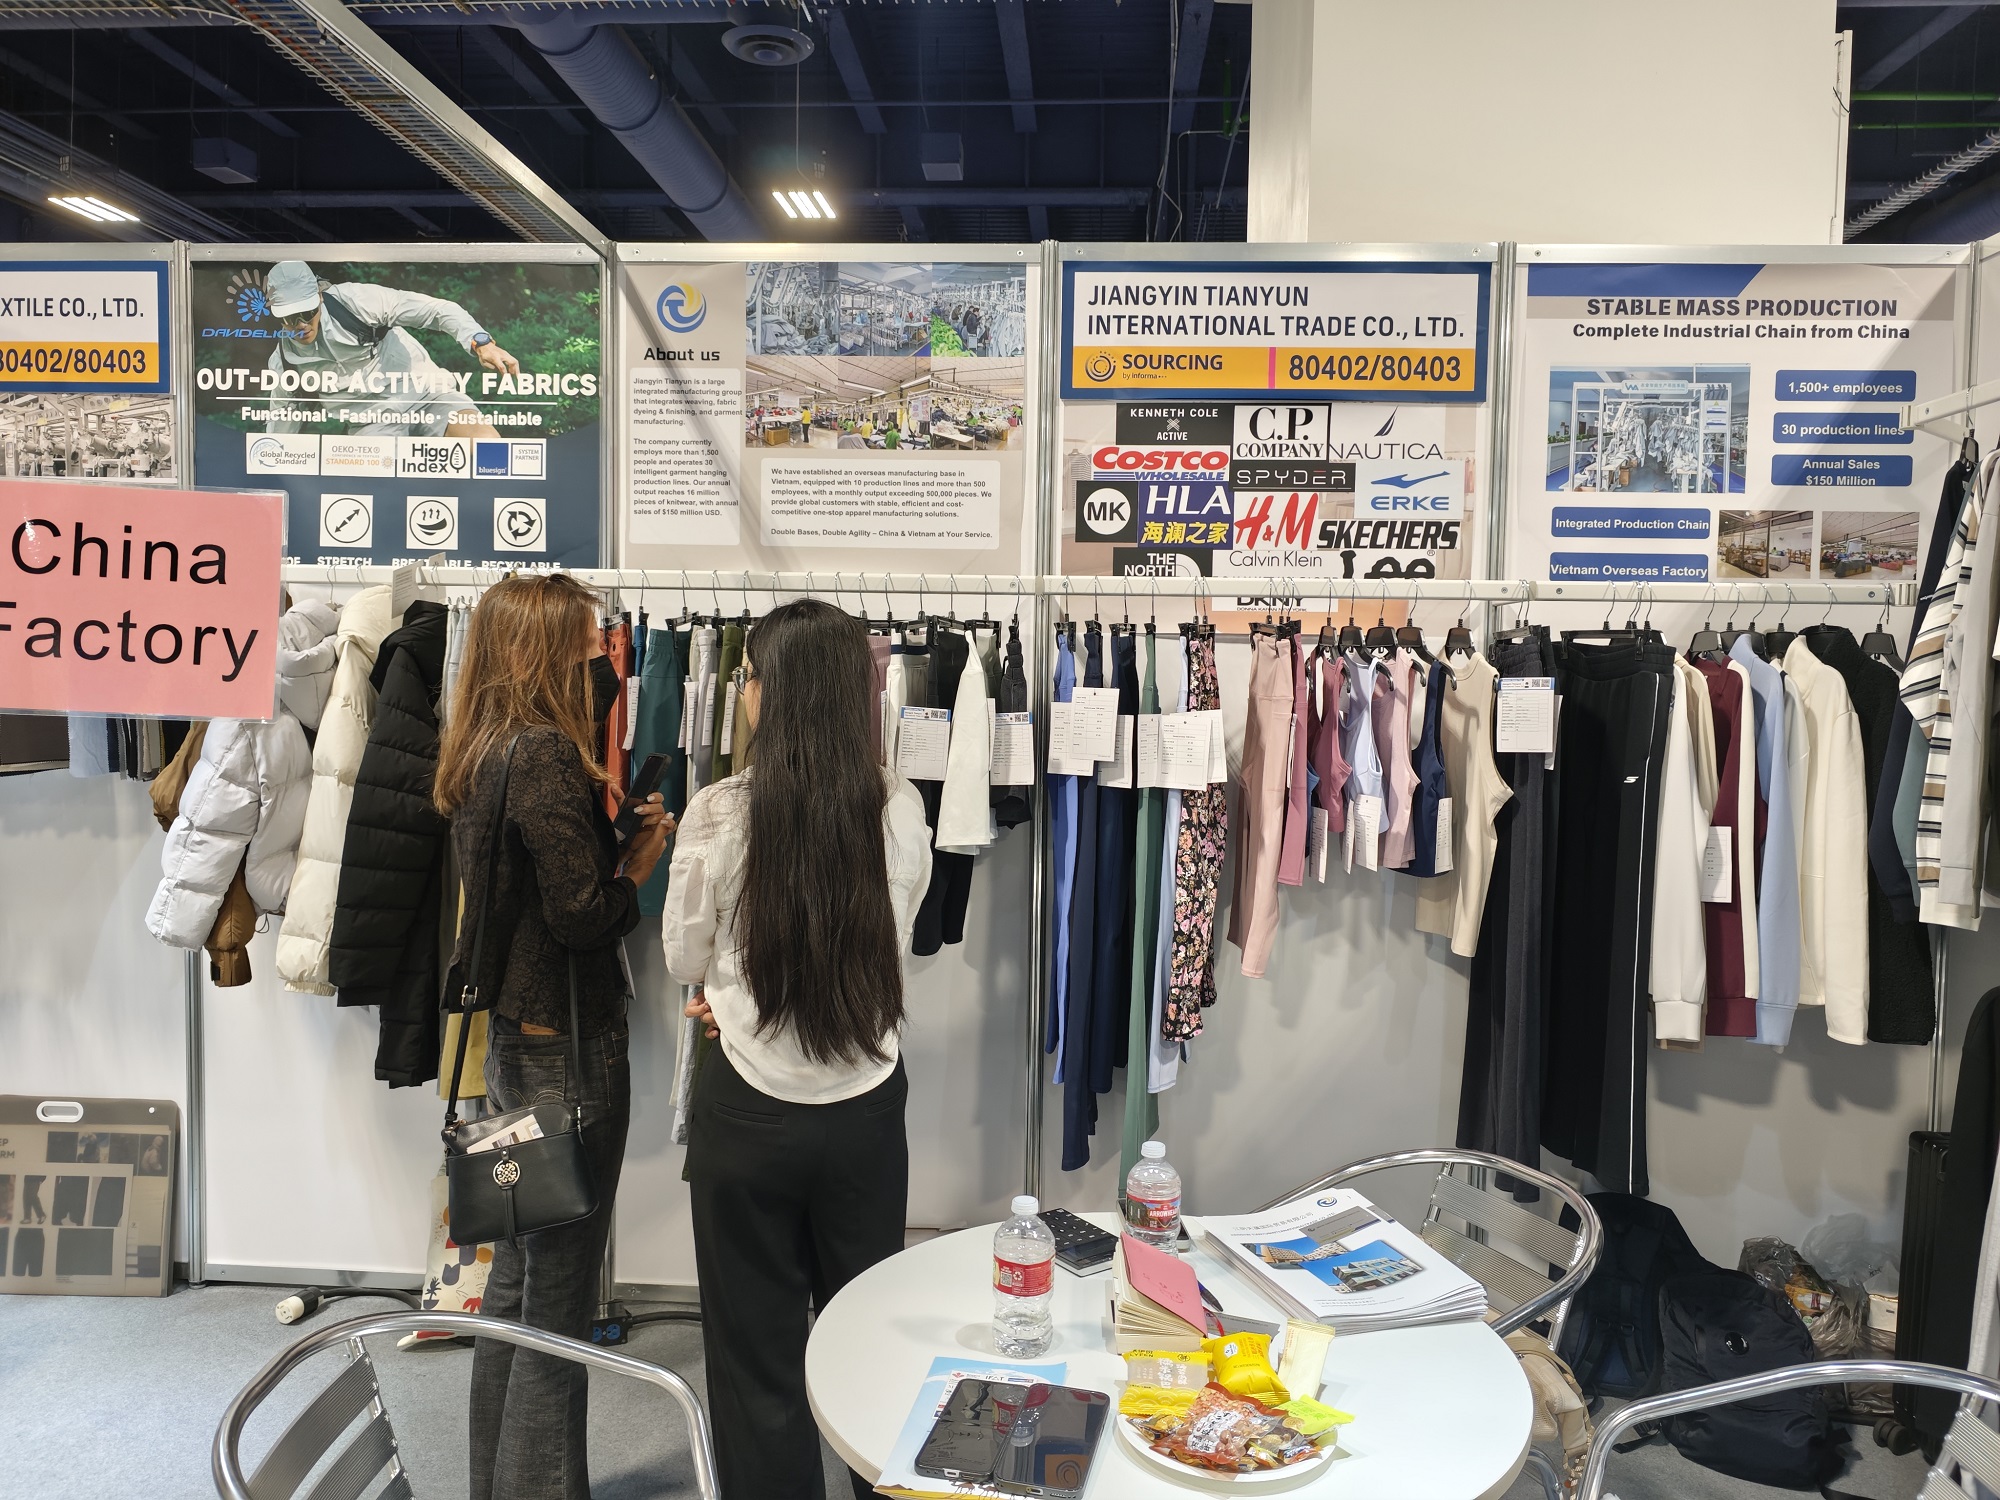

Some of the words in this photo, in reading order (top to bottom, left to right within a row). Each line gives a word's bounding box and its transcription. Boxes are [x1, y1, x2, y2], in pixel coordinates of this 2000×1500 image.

[1087, 286, 1197, 306] JIANGYIN
[1205, 286, 1309, 307] TIANYUN
[0, 298, 54, 316] XTILE
[60, 298, 97, 320] CO.,
[102, 298, 144, 318] LTD.
[1586, 299, 1671, 316] STABLE
[1676, 299, 1740, 316] MASS
[1746, 300, 1898, 317] PRODUCTION
[1088, 315, 1275, 336] INTERNATIONAL
[1281, 316, 1355, 336] TRADE
[1363, 317, 1408, 340] CO.,
[1415, 317, 1464, 338] LTD.
[1573, 324, 1659, 340] Complete
[1663, 324, 1750, 339] Industrial
[1755, 324, 1806, 339] Chain
[1811, 324, 1853, 339] from
[1858, 325, 1910, 339] China
[0, 348, 146, 374] 0402/80403
[644, 347, 694, 361] About
[701, 349, 720, 362] us
[1123, 354, 1223, 370] SOURCING
[1289, 355, 1461, 382] 80402/80403
[197, 368, 338, 393] OUT-DOOR
[348, 368, 472, 394] ACTIVITY
[482, 372, 598, 396] FABRICS
[1788, 383, 1829, 395] 1,500+
[1832, 383, 1903, 397] employees
[448, 411, 542, 426] Sustainable
[1130, 408, 1185, 418] KENNETH
[1190, 409, 1218, 418] COLE
[1248, 407, 1314, 442] C.P.
[1782, 425, 1797, 436] 30
[1800, 424, 1871, 438] production
[1874, 425, 1905, 436] lines
[1156, 431, 1188, 440] ACTIVE
[412, 443, 448, 462] Higg
[1093, 447, 1229, 470] COSTCO
[1236, 444, 1325, 458] COMPANY
[1328, 443, 1443, 460] NAUTICA
[402, 458, 448, 473] Index
[1803, 459, 1844, 470] Annual
[1848, 460, 1880, 470] Sales
[1134, 472, 1225, 480] WHOLESALE
[1237, 470, 1347, 486] SPYDER
[1806, 475, 1833, 487] $150
[1836, 475, 1876, 486] Million
[1146, 485, 1232, 515] HLA
[1371, 496, 1449, 510] ERKE
[1087, 502, 1126, 521] MK
[1234, 493, 1319, 550] H&M
[1556, 518, 1611, 531] Integrated
[1614, 518, 1674, 530] Production
[1677, 519, 1709, 530] Chain
[1140, 521, 1230, 545] 海澜之家
[1316, 520, 1459, 550] SKECHERS
[12, 519, 226, 584] China
[1147, 553, 1175, 566] THE
[1229, 550, 1279, 567] Calvin
[1284, 550, 1322, 567] Klein
[1124, 565, 1175, 577] NORTH
[1550, 565, 1599, 576] Vietnam
[1602, 565, 1658, 576] Overseas
[1661, 565, 1708, 578] Factory
